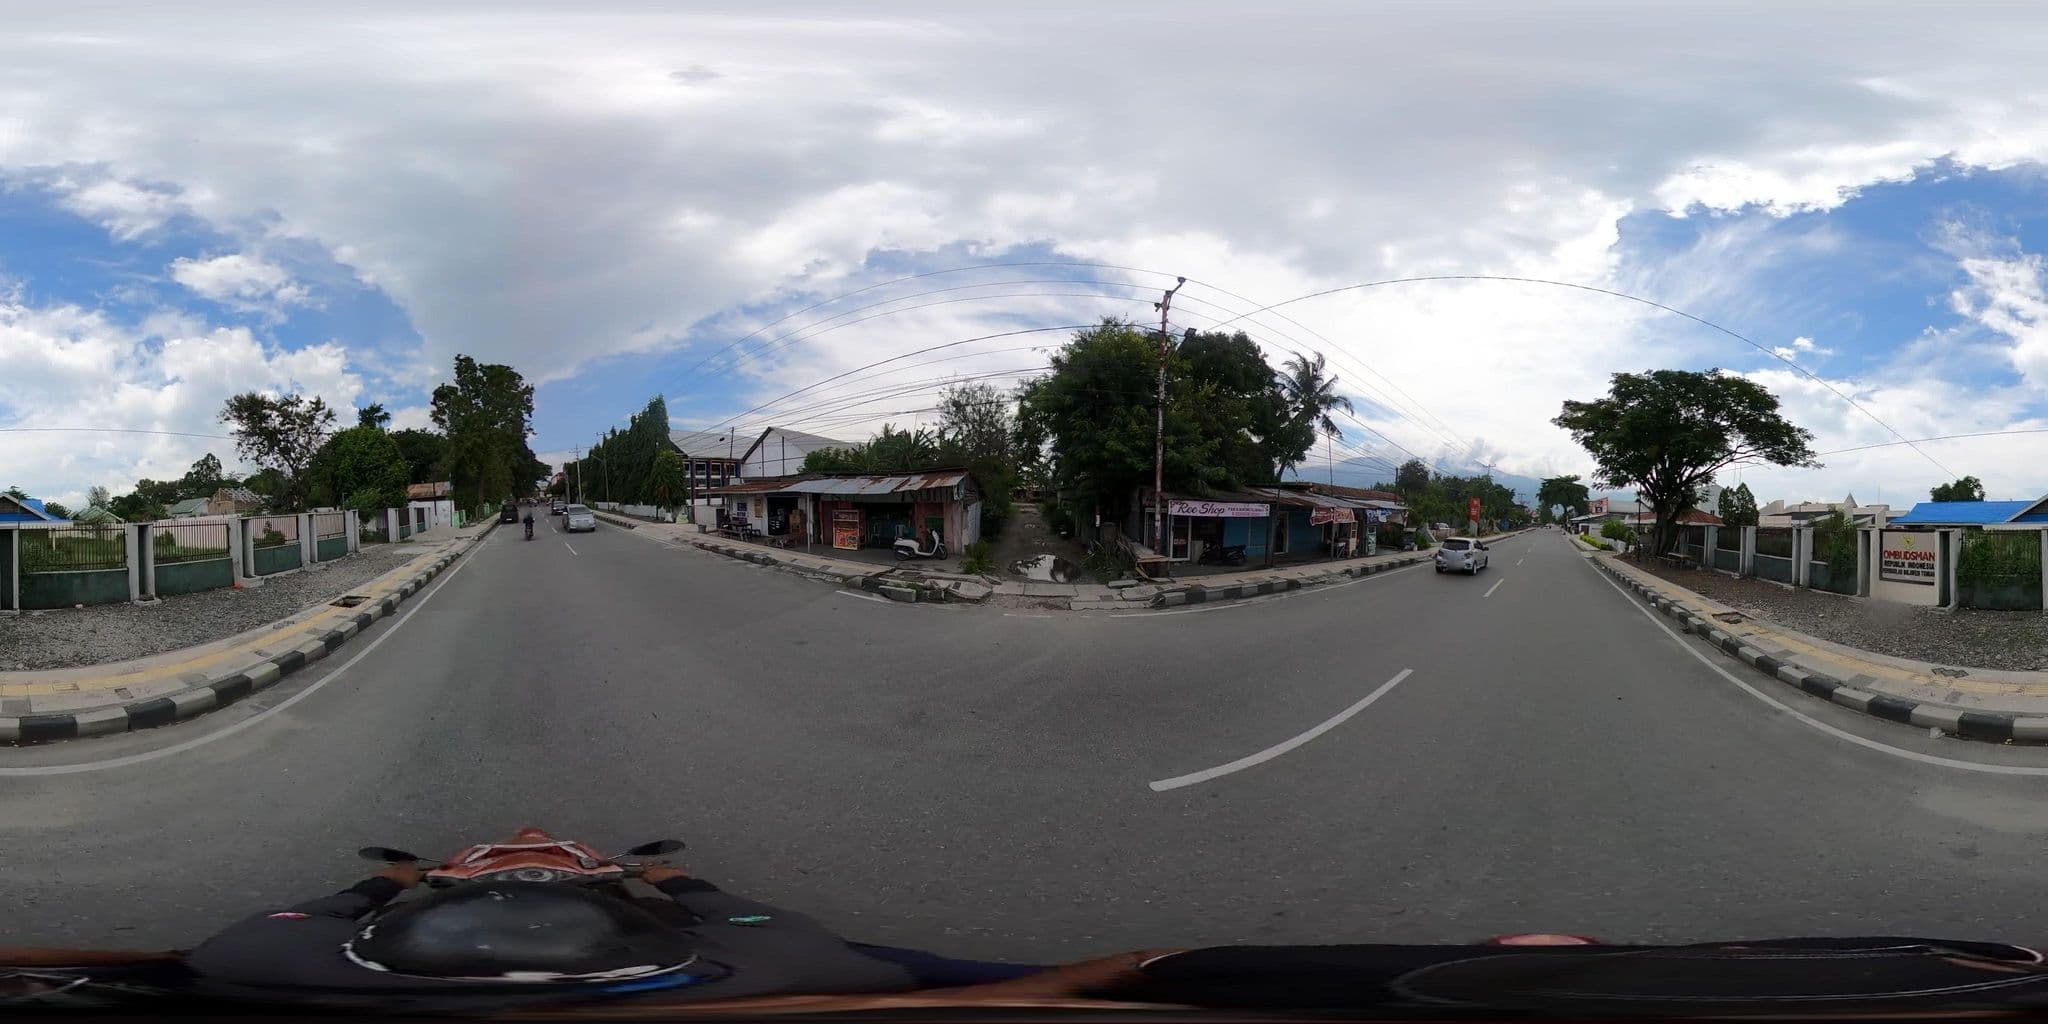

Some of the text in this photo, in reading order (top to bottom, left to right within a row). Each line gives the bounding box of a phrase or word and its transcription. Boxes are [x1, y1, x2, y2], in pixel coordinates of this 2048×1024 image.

[1198, 502, 1225, 517] Shop
[1883, 550, 1936, 562] OMBUDSMAN
[1907, 562, 1935, 570] INDONESIA
